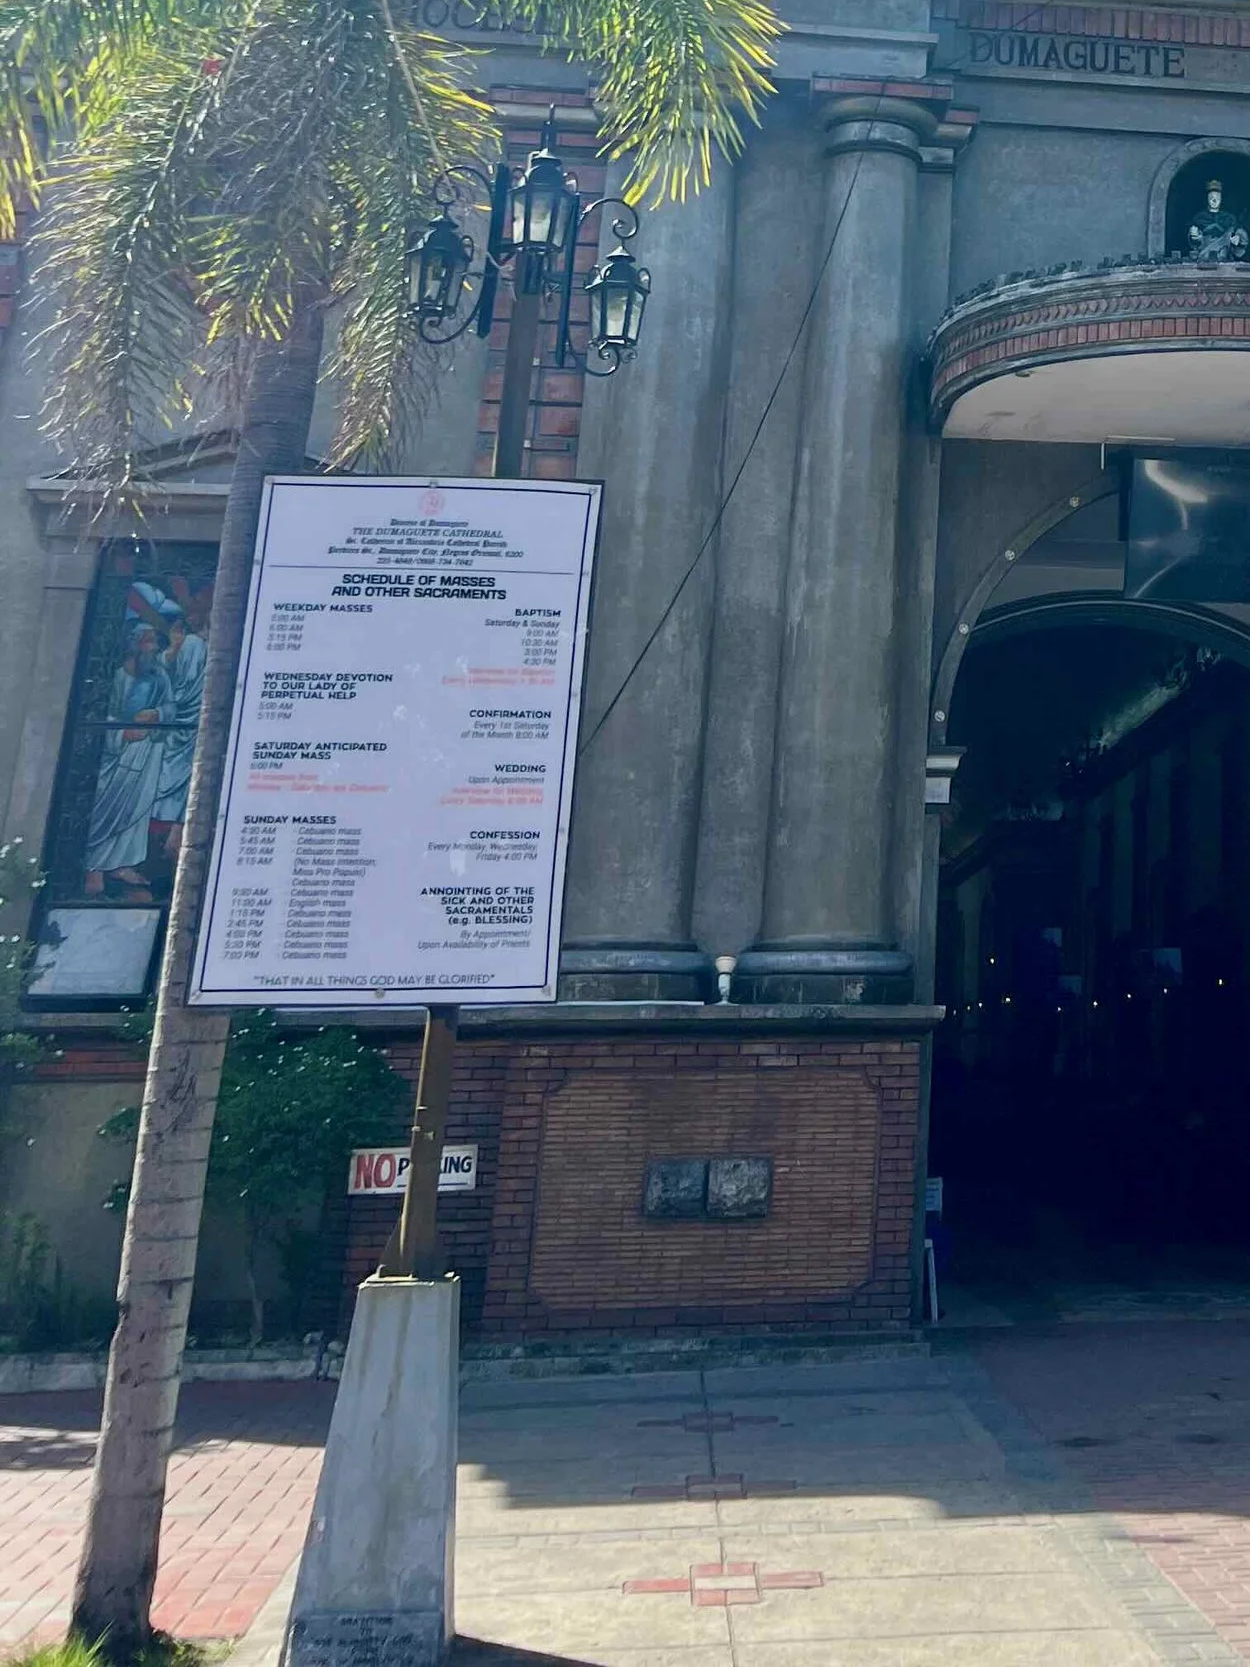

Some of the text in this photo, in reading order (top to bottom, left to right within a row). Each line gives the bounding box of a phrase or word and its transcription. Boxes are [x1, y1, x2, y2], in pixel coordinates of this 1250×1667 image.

[968, 32, 1186, 79] DUMAGUETE
[375, 528, 440, 536] DUMAGUETE
[443, 529, 503, 538] CATHEDRAL
[342, 574, 495, 587] SCHEDULE OF MASSES
[332, 587, 506, 600] AND OTHER SACRAMENTS
[274, 603, 326, 611] WEEKDAY
[516, 609, 561, 617] BAPTISM
[485, 619, 520, 628] Saturday
[531, 620, 559, 628] Sunday
[264, 672, 392, 682] WEDNESDAY DEVOTION
[281, 682, 305, 690] OUR
[309, 682, 337, 690] LADY
[261, 691, 324, 699] PERPETUAL
[470, 710, 551, 718] CONFIRMATION
[474, 721, 548, 730] Every 1st Saturday
[254, 742, 387, 751] SATURDAY ANTICIPATED
[244, 816, 336, 824] SUNDAY MASSES
[470, 831, 540, 839] CONFESSION
[420, 887, 491, 895] ANNOINTING
[496, 887, 510, 895] OF
[441, 897, 466, 905] SICK
[498, 896, 534, 904] OTHER
[446, 906, 533, 914] SACRAMENTALS
[475, 916, 532, 924] BLESSING)
[291, 975, 302, 985] IN
[305, 975, 324, 985] ALL
[327, 975, 367, 985] THINGS
[370, 975, 395, 984] GOD
[398, 975, 422, 984] MAY
[425, 974, 436, 984] BE
[397, 1156, 472, 1176] PING
[354, 1154, 396, 1189] NO
